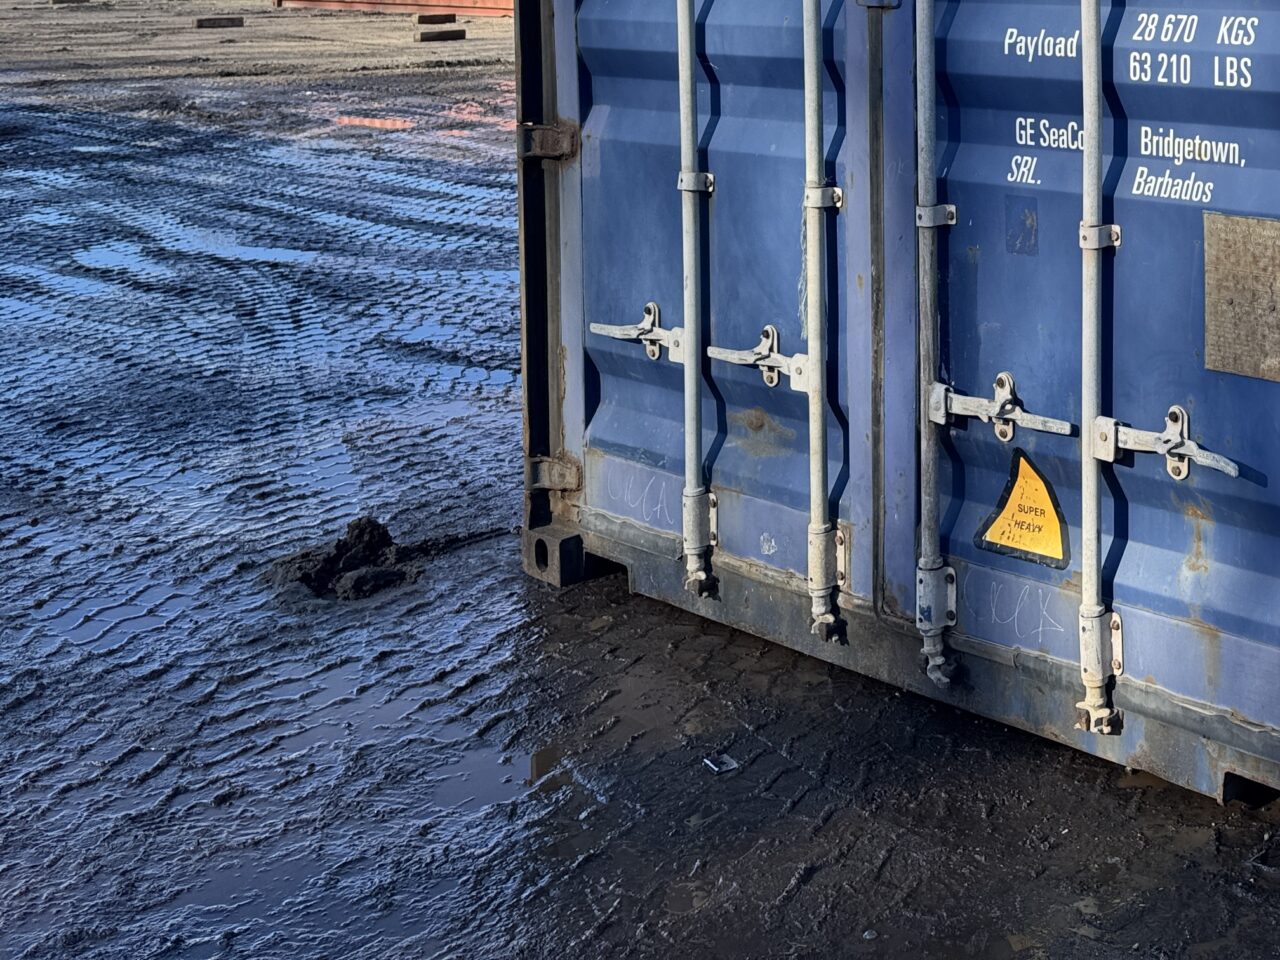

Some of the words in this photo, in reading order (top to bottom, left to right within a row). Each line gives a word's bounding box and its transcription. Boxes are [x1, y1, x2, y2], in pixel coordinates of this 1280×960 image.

[1004, 28, 1080, 62] Payload
[1132, 13, 1158, 41] 28
[1160, 14, 1199, 43] 670
[1217, 16, 1258, 45] KGS
[1129, 52, 1151, 82] 63
[1158, 53, 1191, 84] 210
[1214, 56, 1252, 88] LBS
[1015, 117, 1036, 145] GE
[1039, 119, 1084, 150] SeaCo
[1140, 126, 1246, 167] Bridgetown,
[1007, 155, 1042, 185] SRL.
[1132, 166, 1214, 203] Barbados
[1013, 519, 1044, 534] HEAVY
[1017, 503, 1046, 518] SUPER
